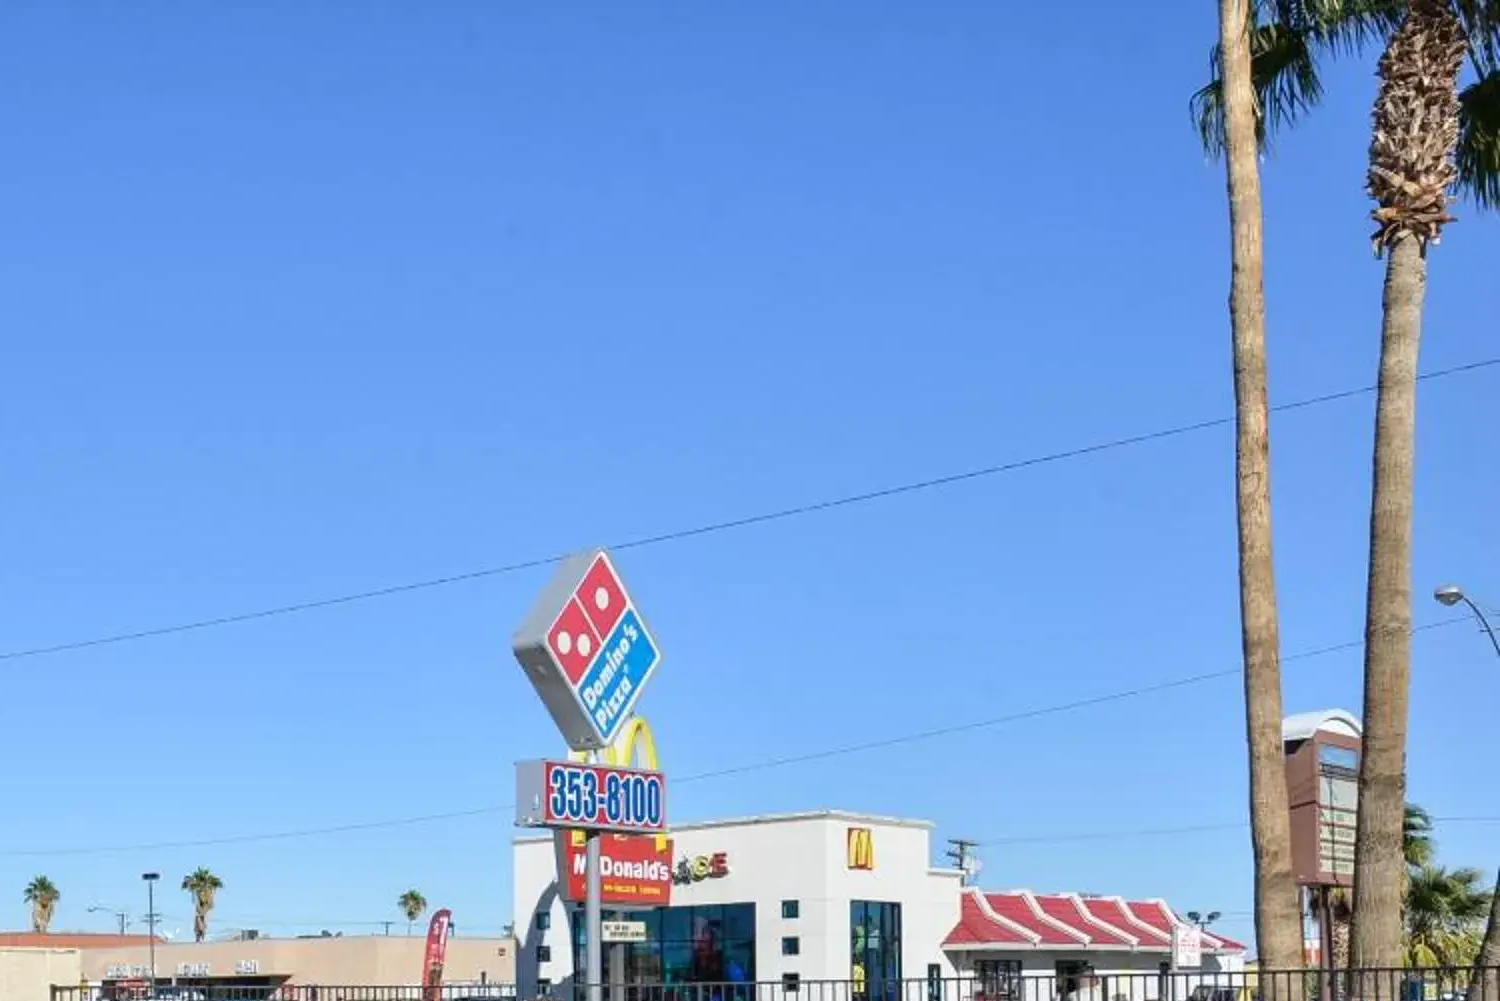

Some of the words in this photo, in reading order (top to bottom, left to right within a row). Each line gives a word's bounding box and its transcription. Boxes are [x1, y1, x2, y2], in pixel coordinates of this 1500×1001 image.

[583, 624, 638, 709] Domino's
[595, 675, 632, 731] Pizza
[551, 767, 660, 825] 353-8100
[573, 853, 669, 881] MDonald's
